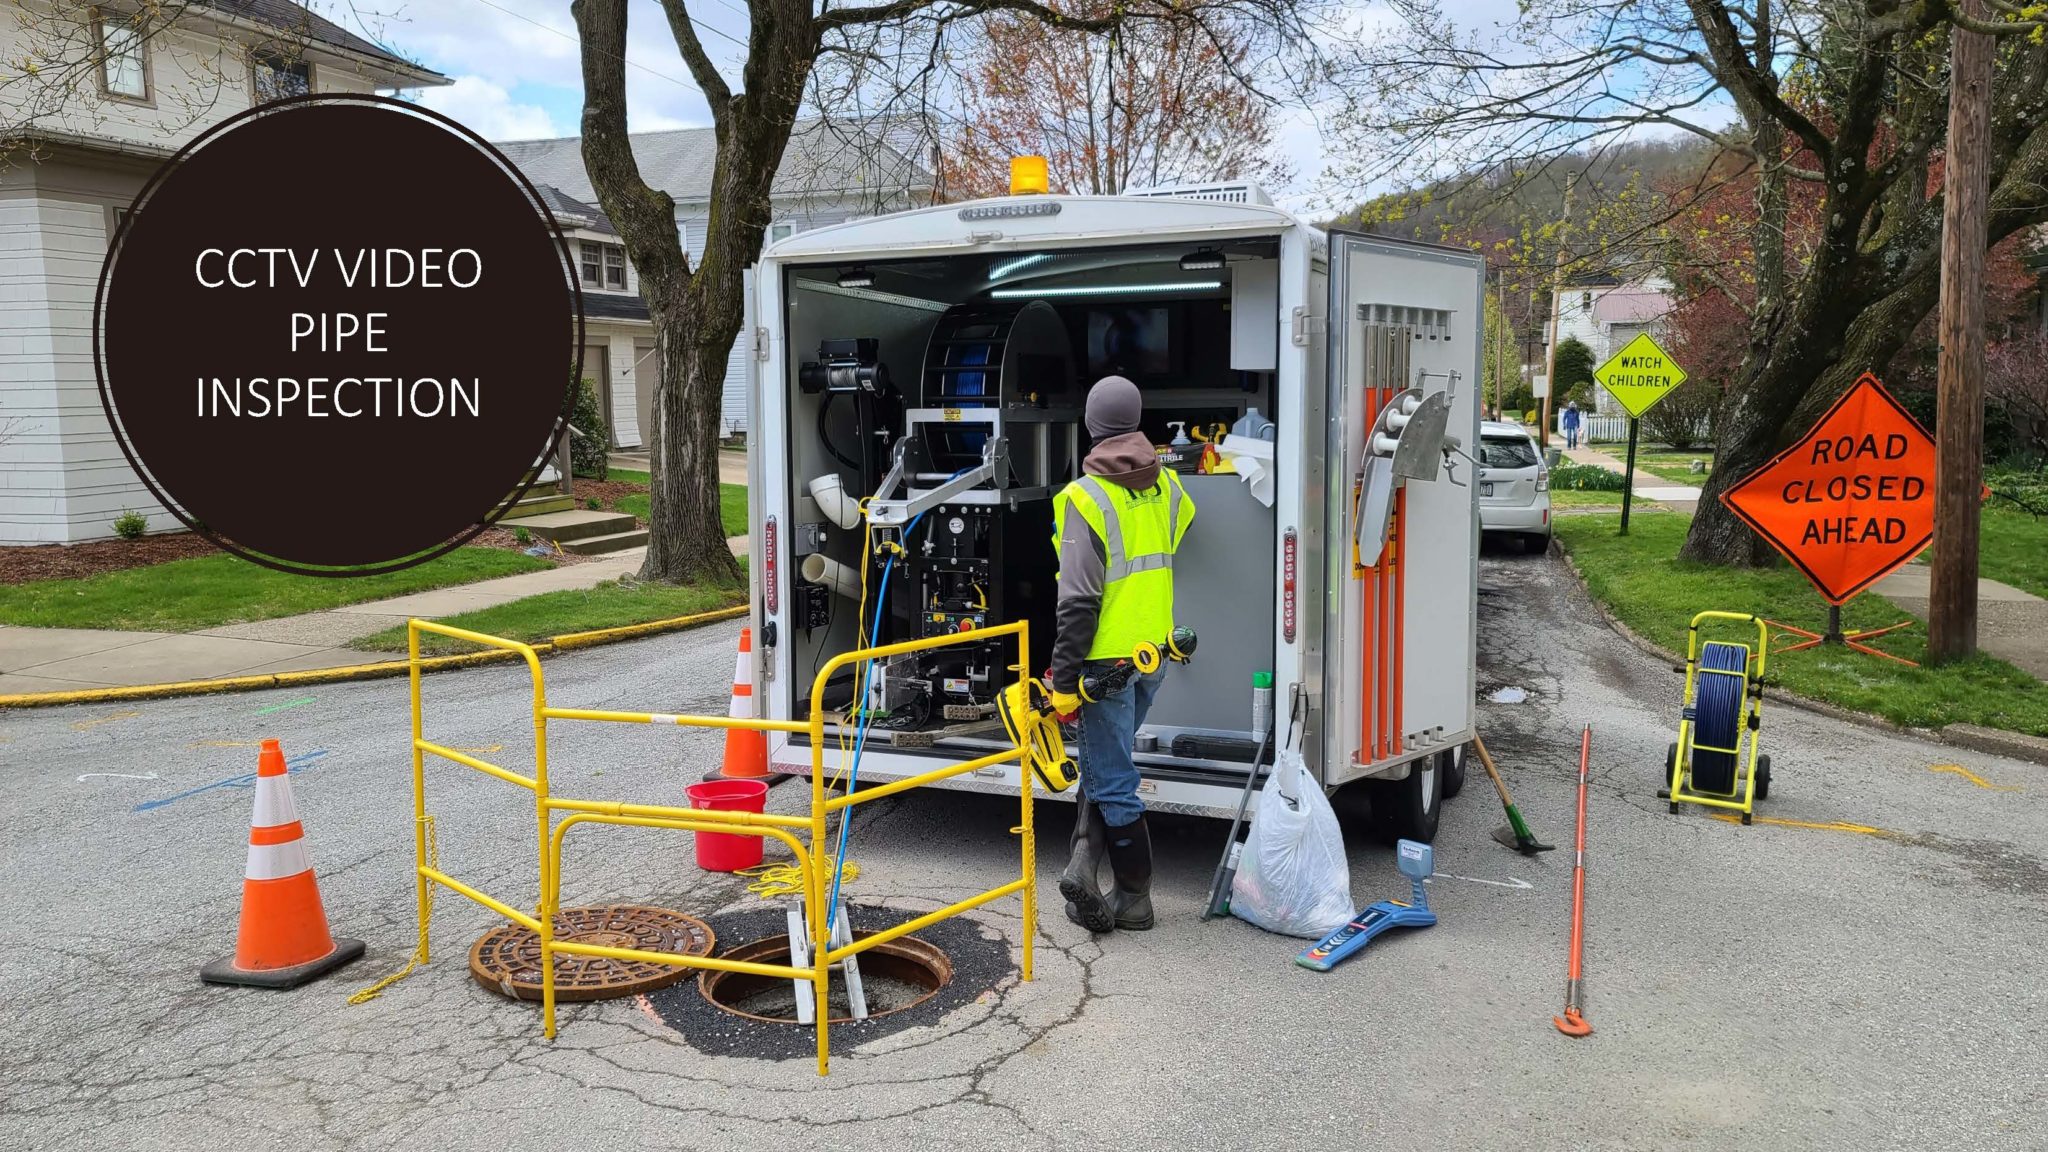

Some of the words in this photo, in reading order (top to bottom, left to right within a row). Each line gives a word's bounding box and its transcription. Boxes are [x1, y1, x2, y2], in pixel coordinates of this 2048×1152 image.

[1621, 356, 1662, 369] WATCH
[1608, 374, 1671, 387] CHILDREN
[1810, 433, 1908, 465] ROAD
[1782, 474, 1925, 504] CLOSED
[1800, 516, 1907, 545] AHEAD
